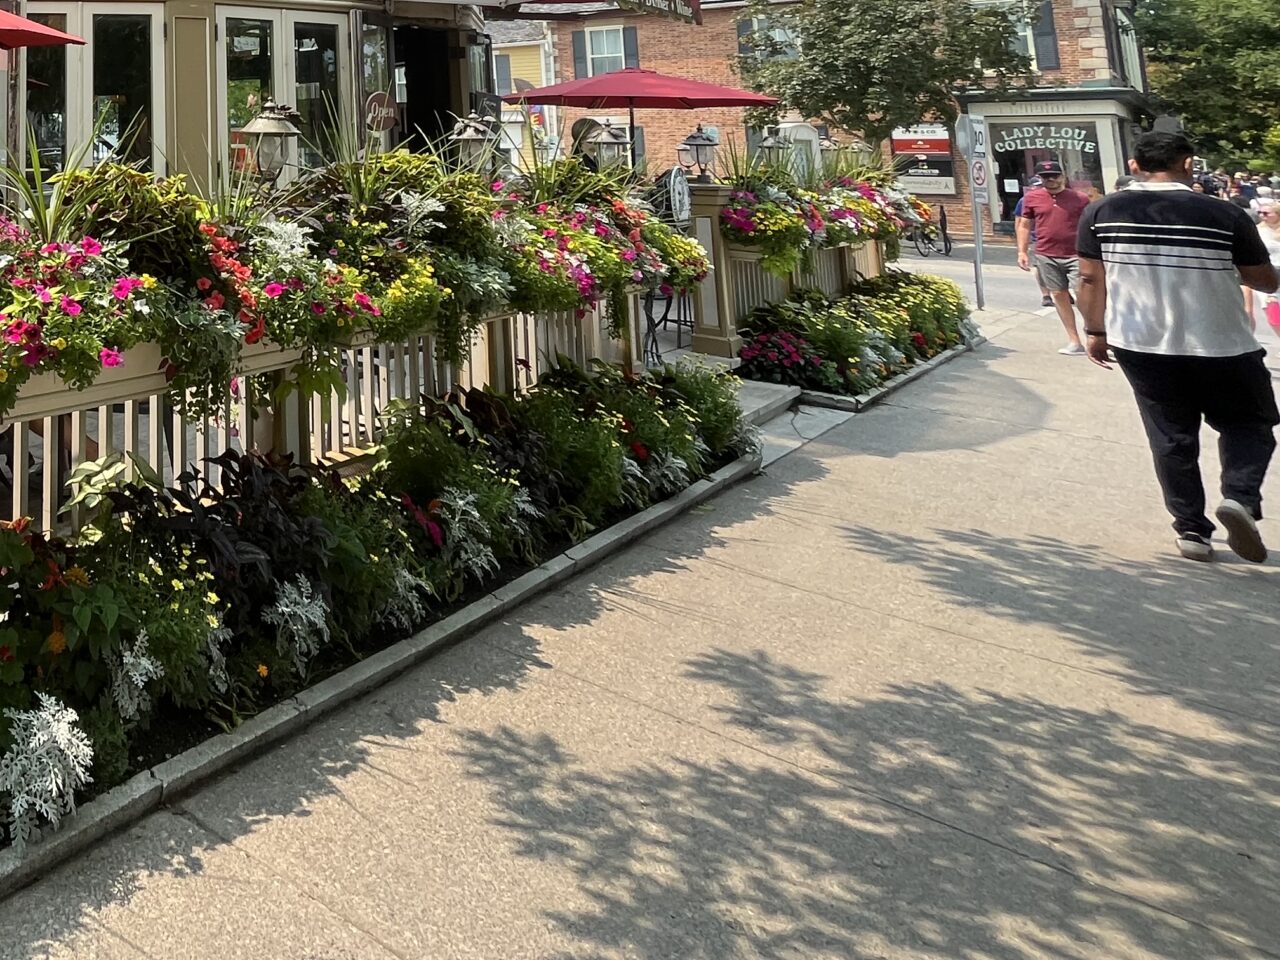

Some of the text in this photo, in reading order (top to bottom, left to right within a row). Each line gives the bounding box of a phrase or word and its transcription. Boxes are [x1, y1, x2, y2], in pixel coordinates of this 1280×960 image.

[371, 101, 394, 120] Open
[1000, 126, 1087, 141] LADY LOU
[994, 138, 1097, 153] COLLECTIVE
